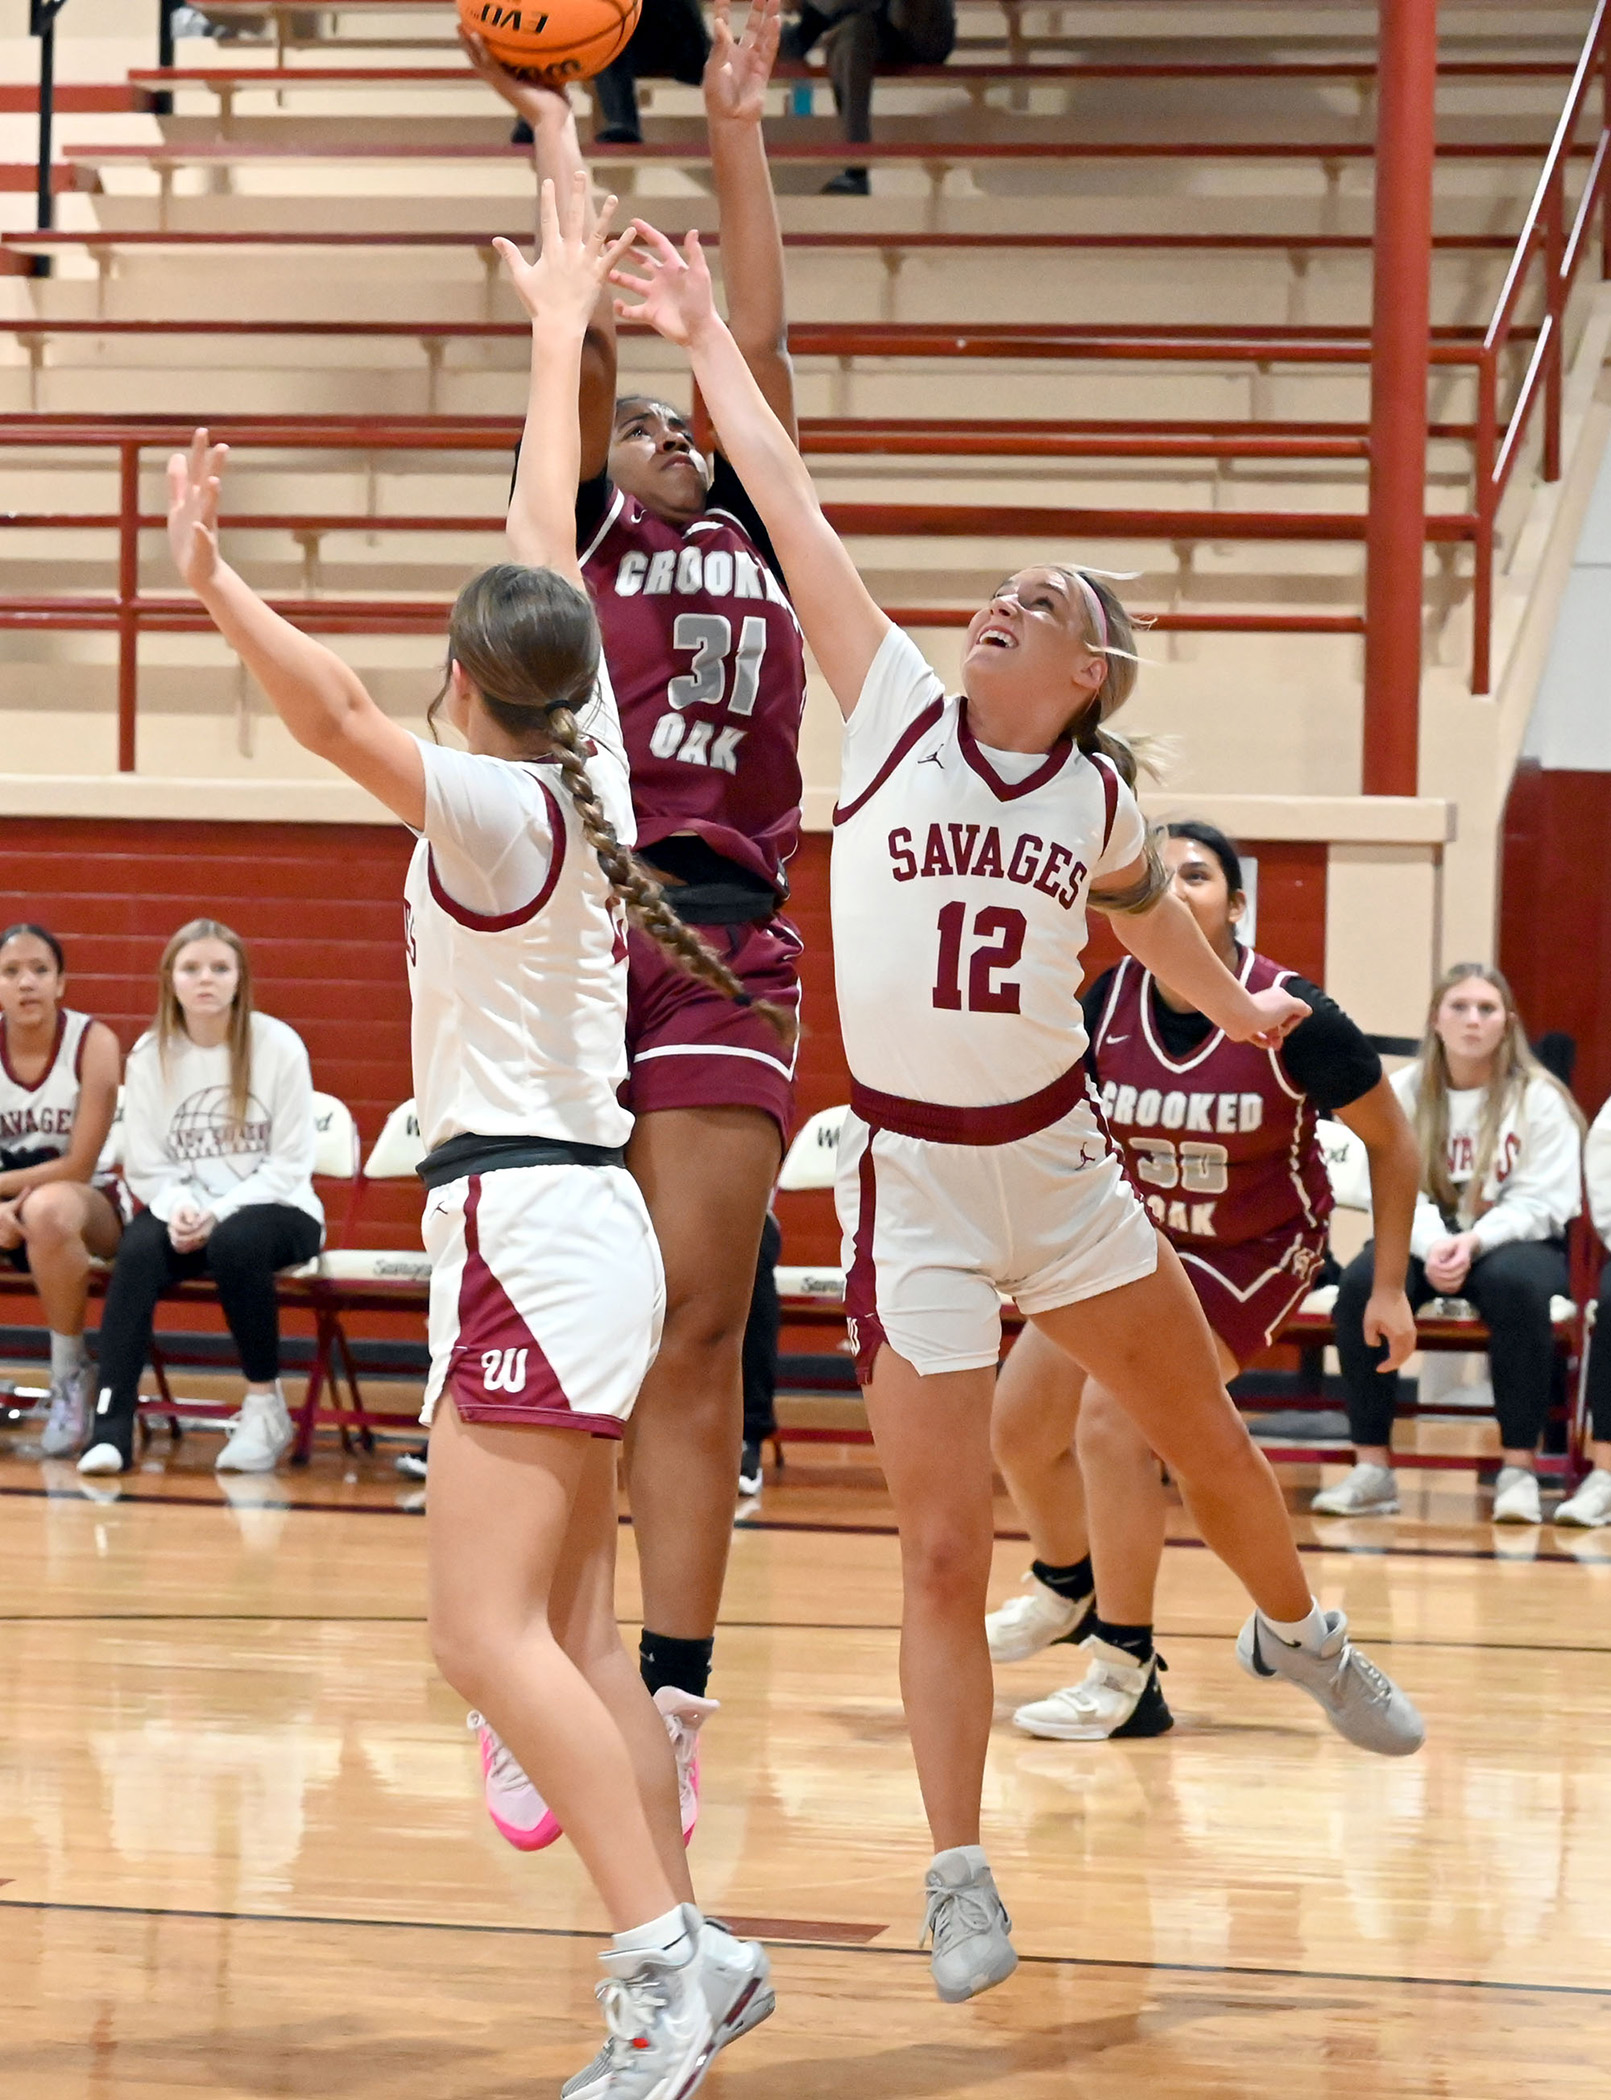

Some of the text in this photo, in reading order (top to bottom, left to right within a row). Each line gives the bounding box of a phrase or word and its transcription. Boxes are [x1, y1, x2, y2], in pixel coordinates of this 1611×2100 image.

[614, 546, 798, 622] CROOK
[667, 613, 766, 716] 31
[650, 712, 748, 775] OAK
[888, 822, 1088, 910] SAVAGES
[932, 900, 1028, 1014] 12
[0, 1108, 72, 1138] AVAGE
[1101, 1080, 1264, 1133] CROOKED
[1128, 1137, 1229, 1194] 30
[481, 1348, 529, 1393] W
